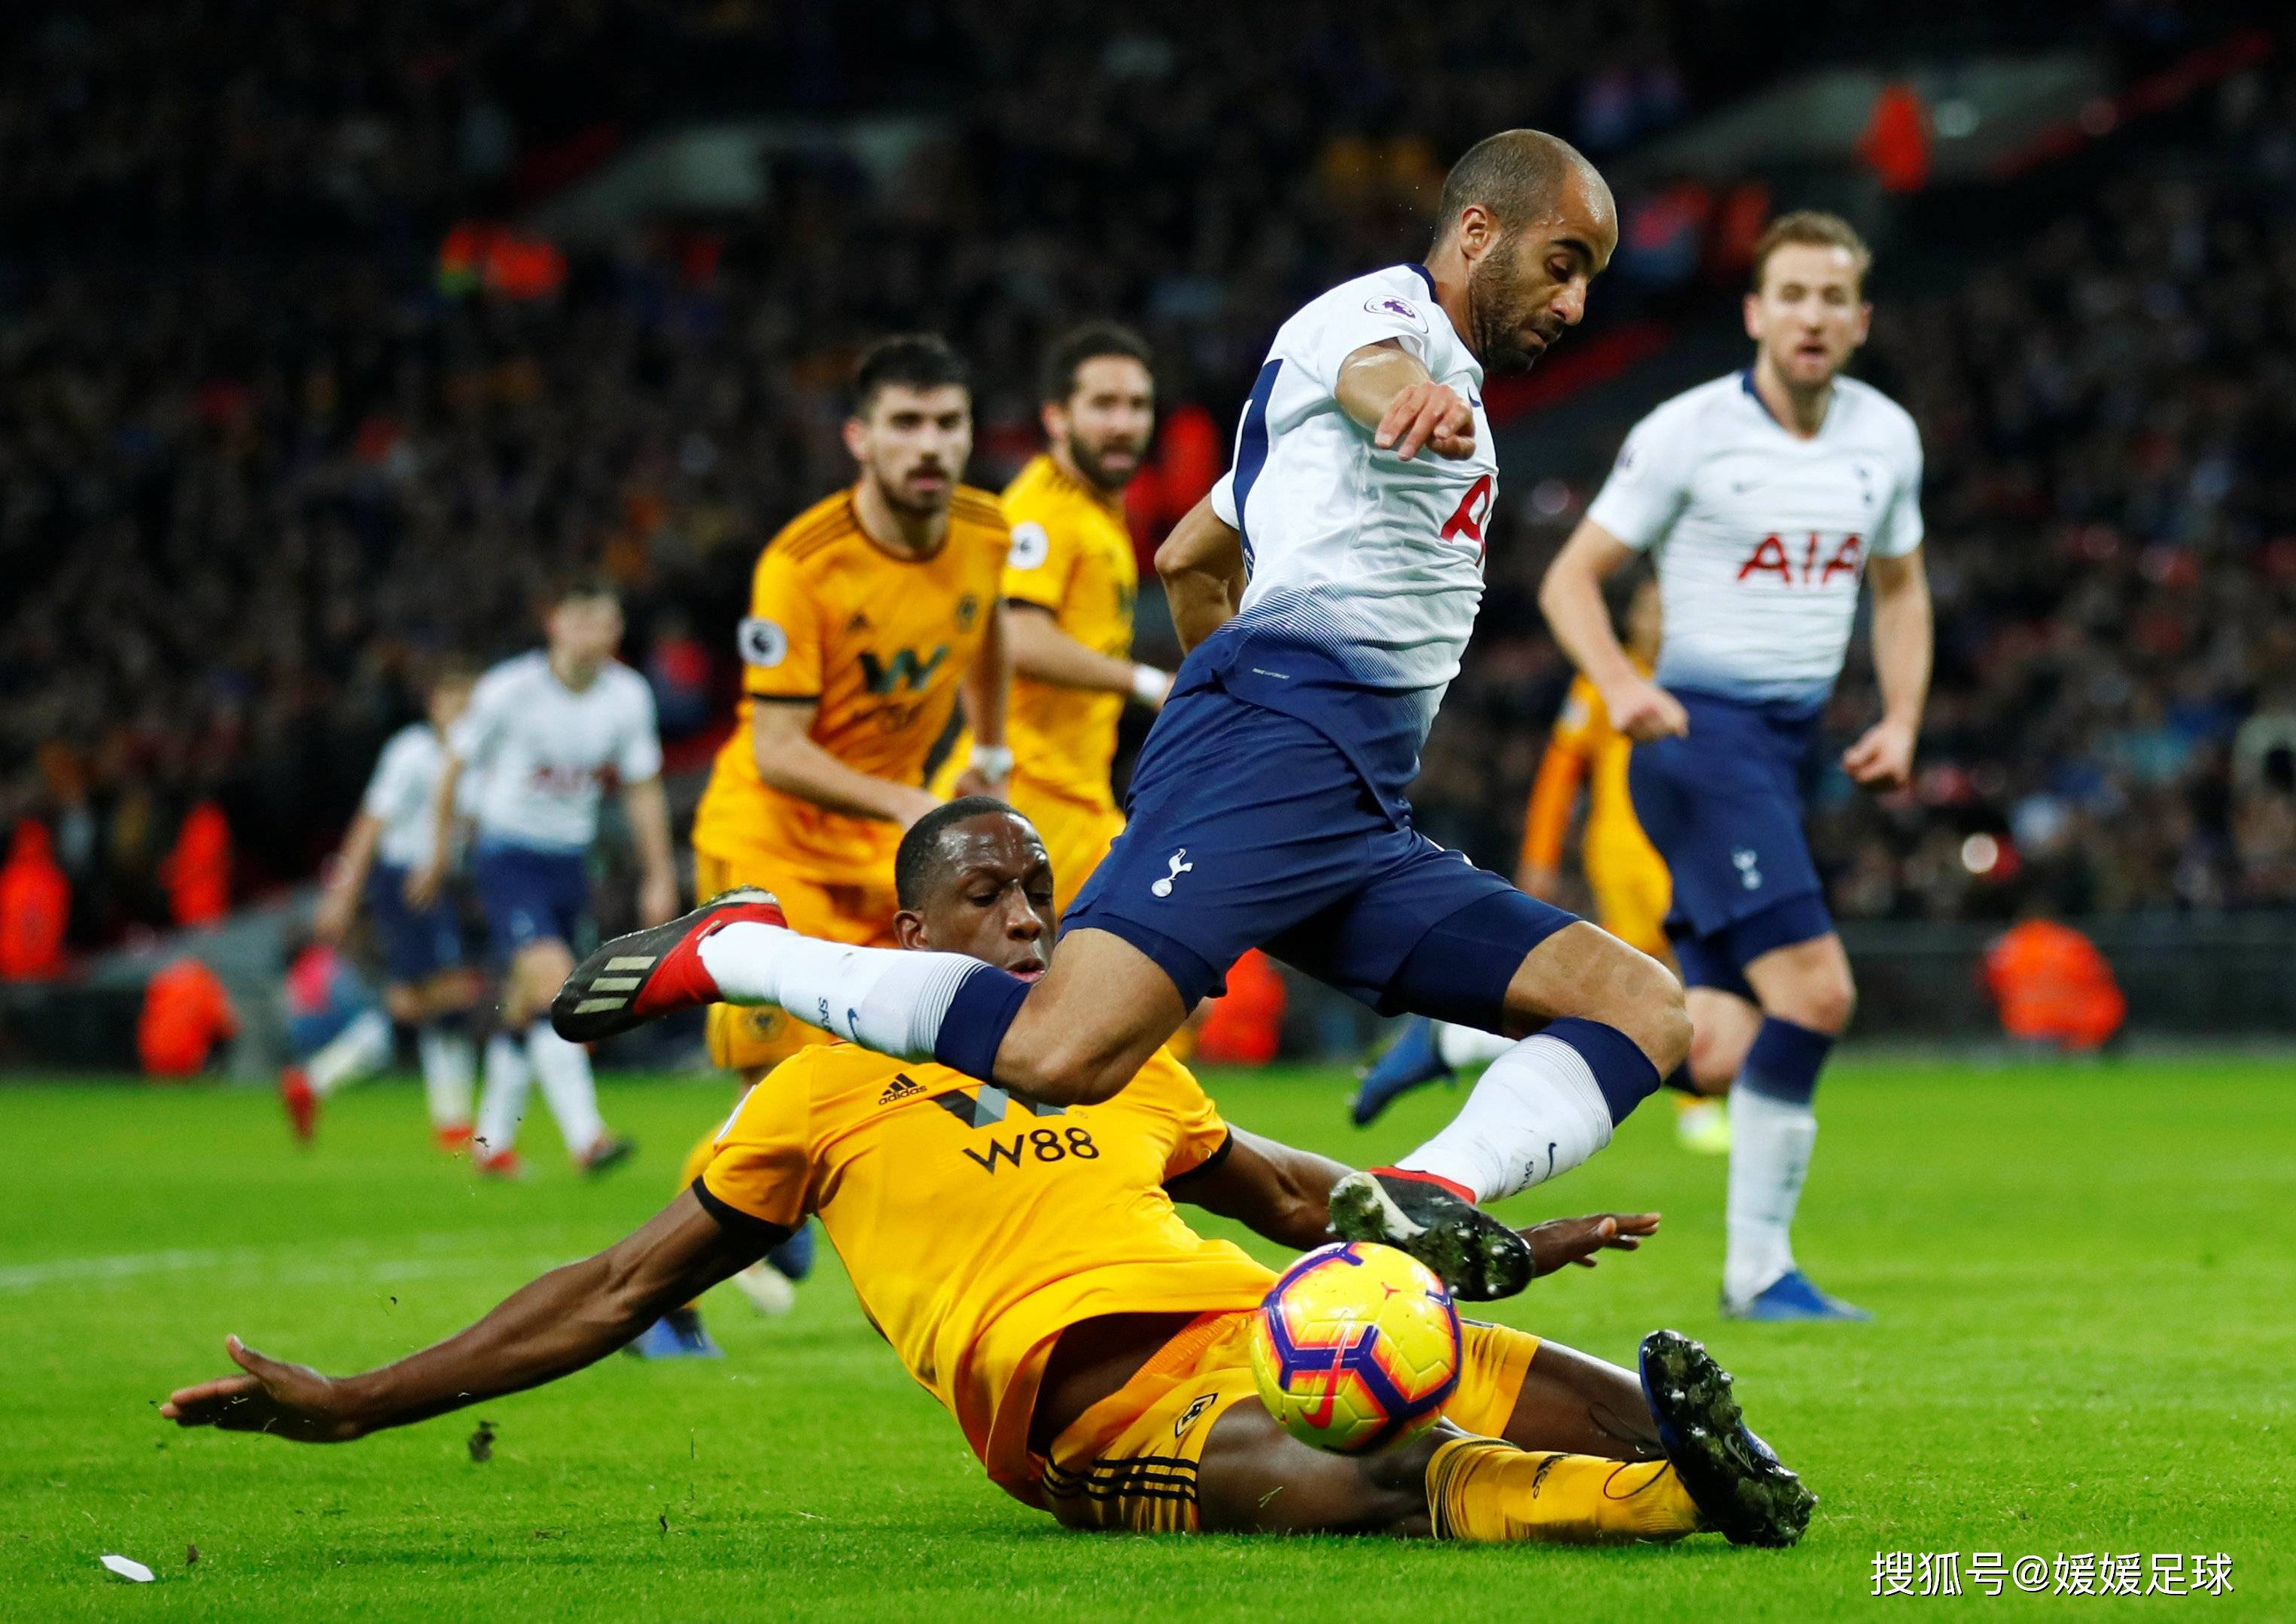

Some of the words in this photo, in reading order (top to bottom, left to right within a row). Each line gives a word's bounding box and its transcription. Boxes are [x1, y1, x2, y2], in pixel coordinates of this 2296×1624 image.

[1737, 530, 1860, 585] AIA
[878, 1084, 928, 1105] adidas
[961, 1126, 1100, 1175] W88
